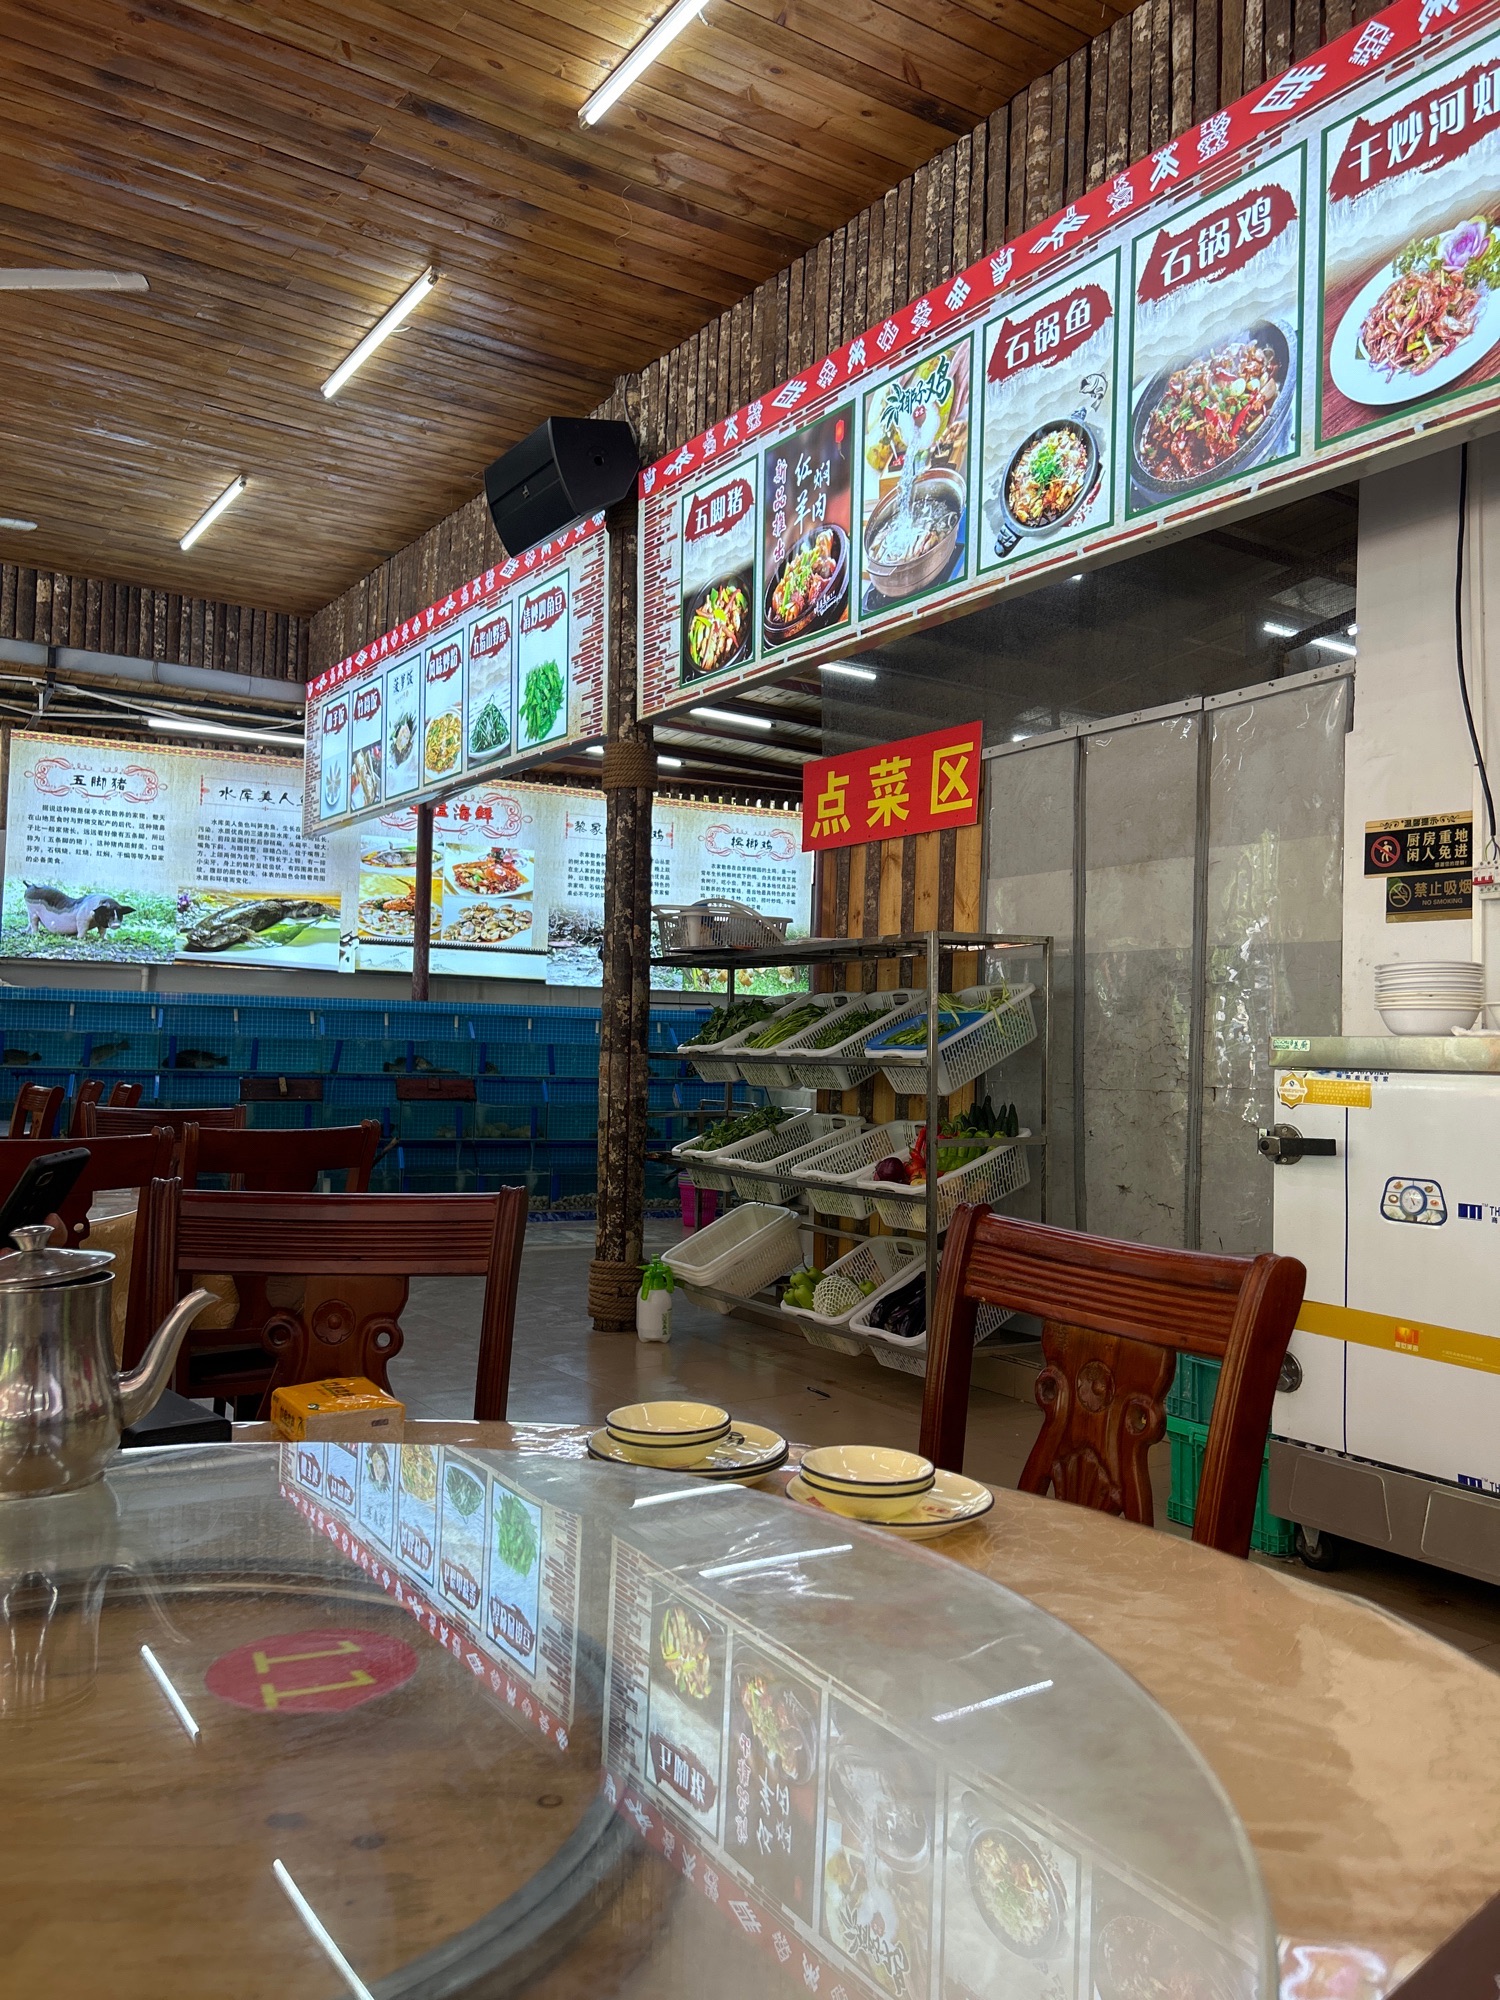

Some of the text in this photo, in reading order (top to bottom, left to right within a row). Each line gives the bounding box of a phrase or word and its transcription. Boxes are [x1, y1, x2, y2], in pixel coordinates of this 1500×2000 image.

[1348, 67, 1500, 183] 干炒河虾
[1161, 196, 1272, 287] 石锅鸡
[1004, 297, 1092, 370] 石锅鱼
[694, 485, 744, 535] 五脚猪
[772, 458, 788, 563] 新品推出
[523, 590, 563, 631] 清炒四角豆
[473, 619, 507, 656] 五指山野菜
[69, 774, 127, 791] 五脚猪
[810, 741, 974, 838] 点菜区
[1406, 828, 1469, 847] 厨房重地
[1406, 844, 1468, 863] 闲人免进
[1414, 878, 1471, 898] 禁止吸烟
[1433, 897, 1463, 905] SMOKING
[252, 1640, 377, 1709] 11
